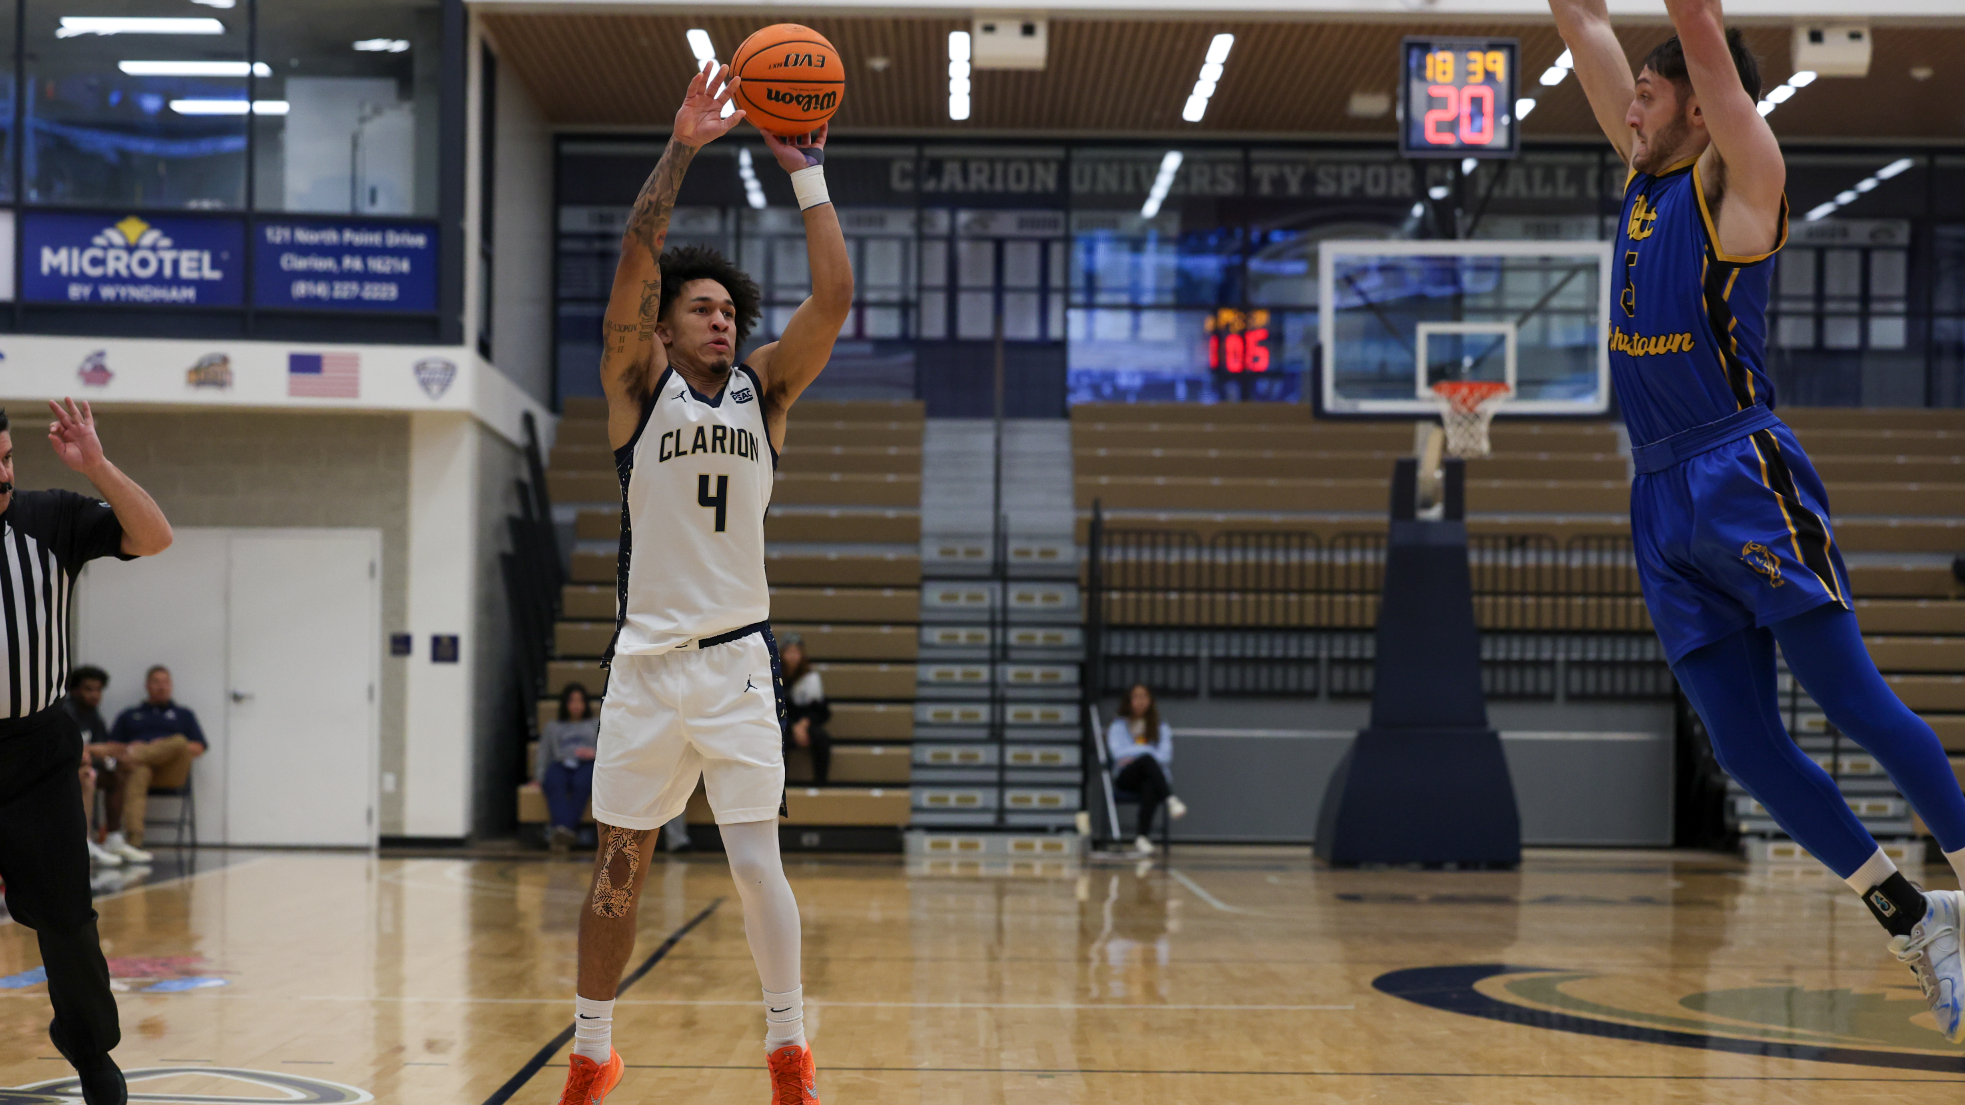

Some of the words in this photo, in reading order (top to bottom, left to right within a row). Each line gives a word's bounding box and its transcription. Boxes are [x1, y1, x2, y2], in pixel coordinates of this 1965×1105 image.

[783, 53, 826, 68] EVO
[1425, 50, 1455, 83] 18
[1466, 50, 1505, 83] 39
[766, 87, 837, 112] Wilson
[1424, 85, 1495, 145] 20
[889, 160, 1058, 193] CLARION
[1072, 161, 1306, 196] UNIVRSTY
[265, 225, 292, 245] 121
[294, 226, 341, 246] North
[342, 228, 383, 248] Point
[385, 229, 428, 249] Drive
[41, 246, 224, 281] MICROTEL
[280, 252, 340, 274] Clarion,
[342, 254, 365, 273] PA
[68, 282, 93, 301] BY
[99, 284, 197, 304] WYNDHAM
[659, 424, 759, 465] CLARION
[697, 473, 729, 533] 4
